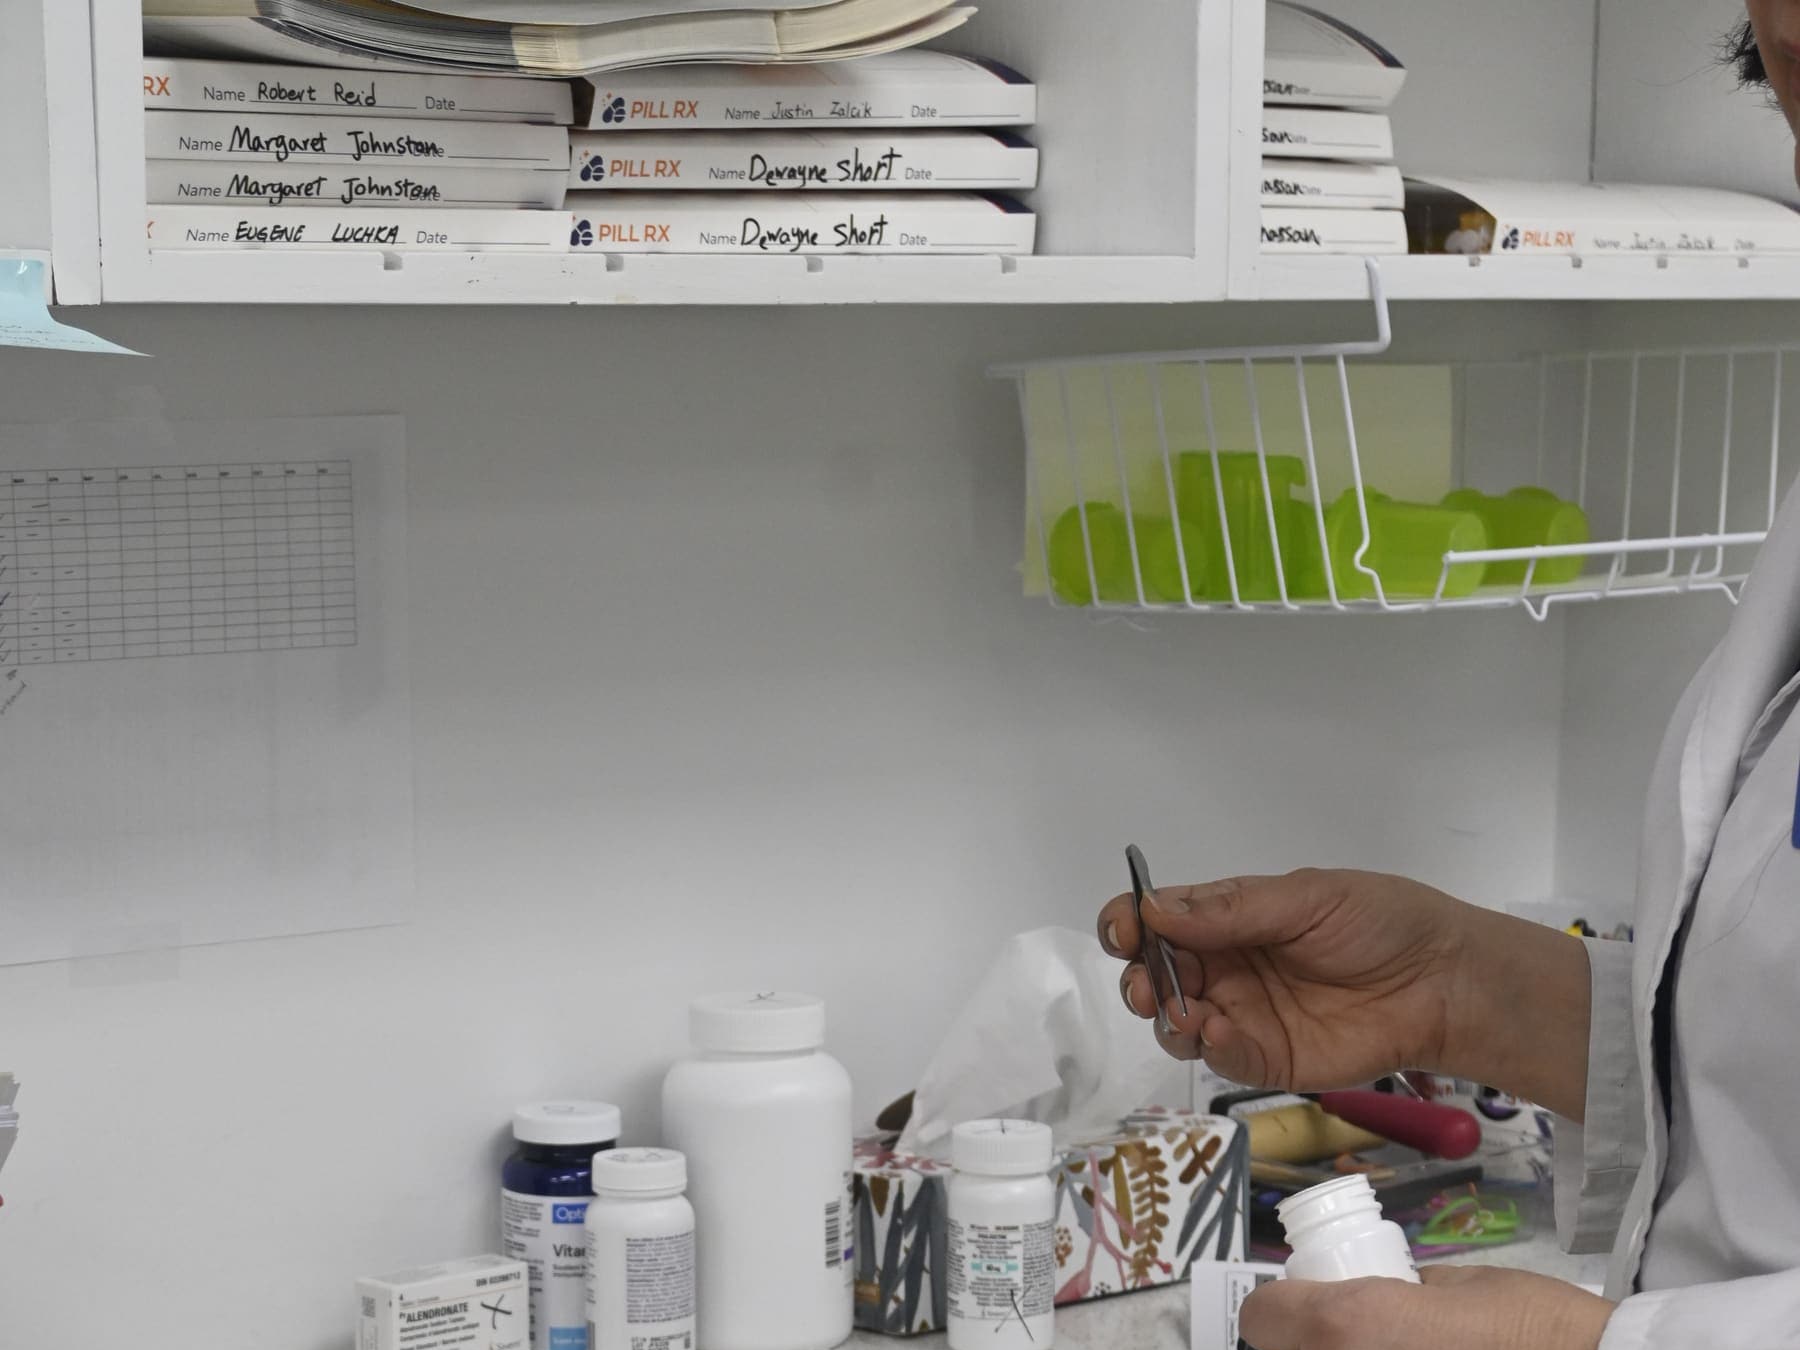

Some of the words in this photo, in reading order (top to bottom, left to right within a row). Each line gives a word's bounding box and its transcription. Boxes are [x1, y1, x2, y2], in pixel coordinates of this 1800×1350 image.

[203, 86, 246, 101] Name
[257, 82, 316, 101] Robert
[335, 82, 376, 106] Reid
[425, 96, 455, 111] Date
[630, 101, 669, 119] PILL
[674, 100, 699, 118] RX
[725, 107, 760, 120] Name
[911, 105, 936, 118] Date
[179, 137, 223, 151] Name
[229, 125, 327, 162] Margaret
[346, 131, 438, 161] Johnston
[610, 160, 650, 178] PILL
[654, 159, 681, 177] RX
[709, 168, 745, 180] Name
[749, 154, 828, 188] Dewayne
[905, 168, 931, 180] Date
[178, 184, 222, 197] Name
[226, 174, 327, 206] Margaret
[186, 229, 229, 242] Name
[236, 221, 306, 241] EUGENE
[416, 231, 447, 244] Date
[599, 224, 638, 242] PILL
[644, 225, 670, 241] RX
[700, 232, 736, 245] Name
[741, 218, 818, 252] Dewayne
[900, 233, 927, 246] Date
[1522, 231, 1552, 248] PILL
[406, 1302, 468, 1323] ALENDRONATE
